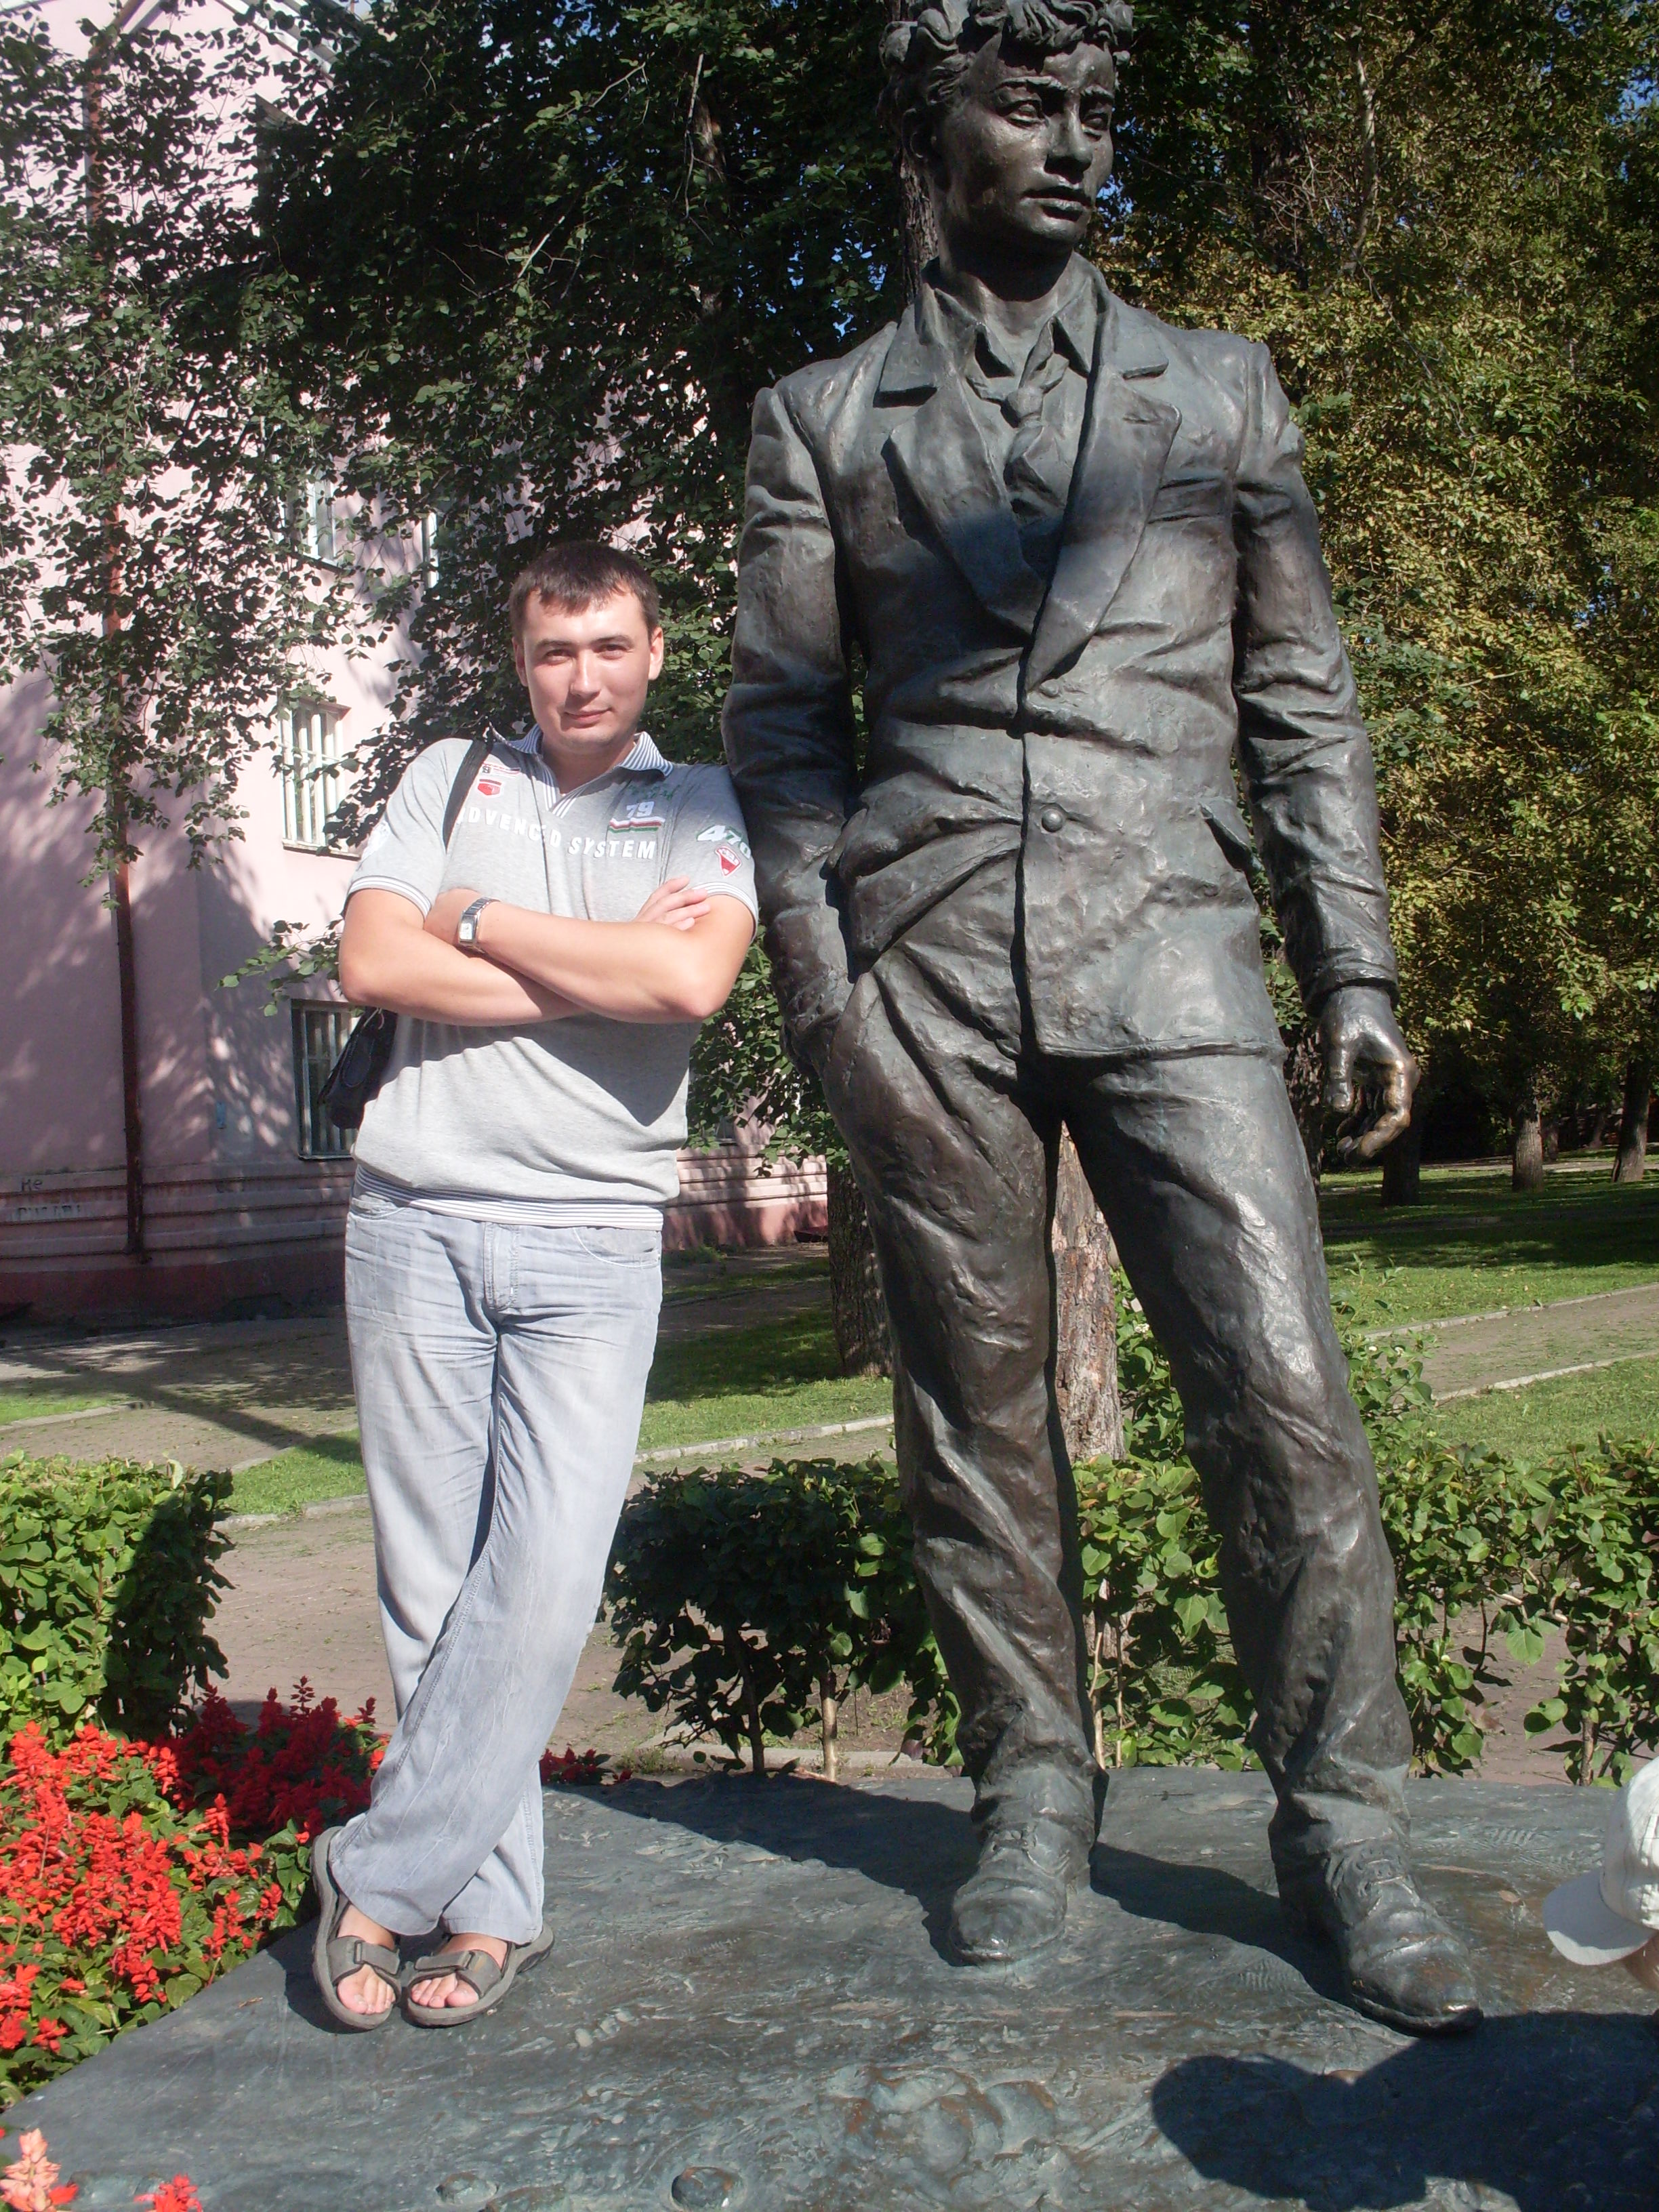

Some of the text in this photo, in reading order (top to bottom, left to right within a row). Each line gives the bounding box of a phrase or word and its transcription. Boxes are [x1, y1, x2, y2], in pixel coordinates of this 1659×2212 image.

[626, 801, 655, 818] 79
[457, 806, 656, 859] DVENCD SYSTEM
